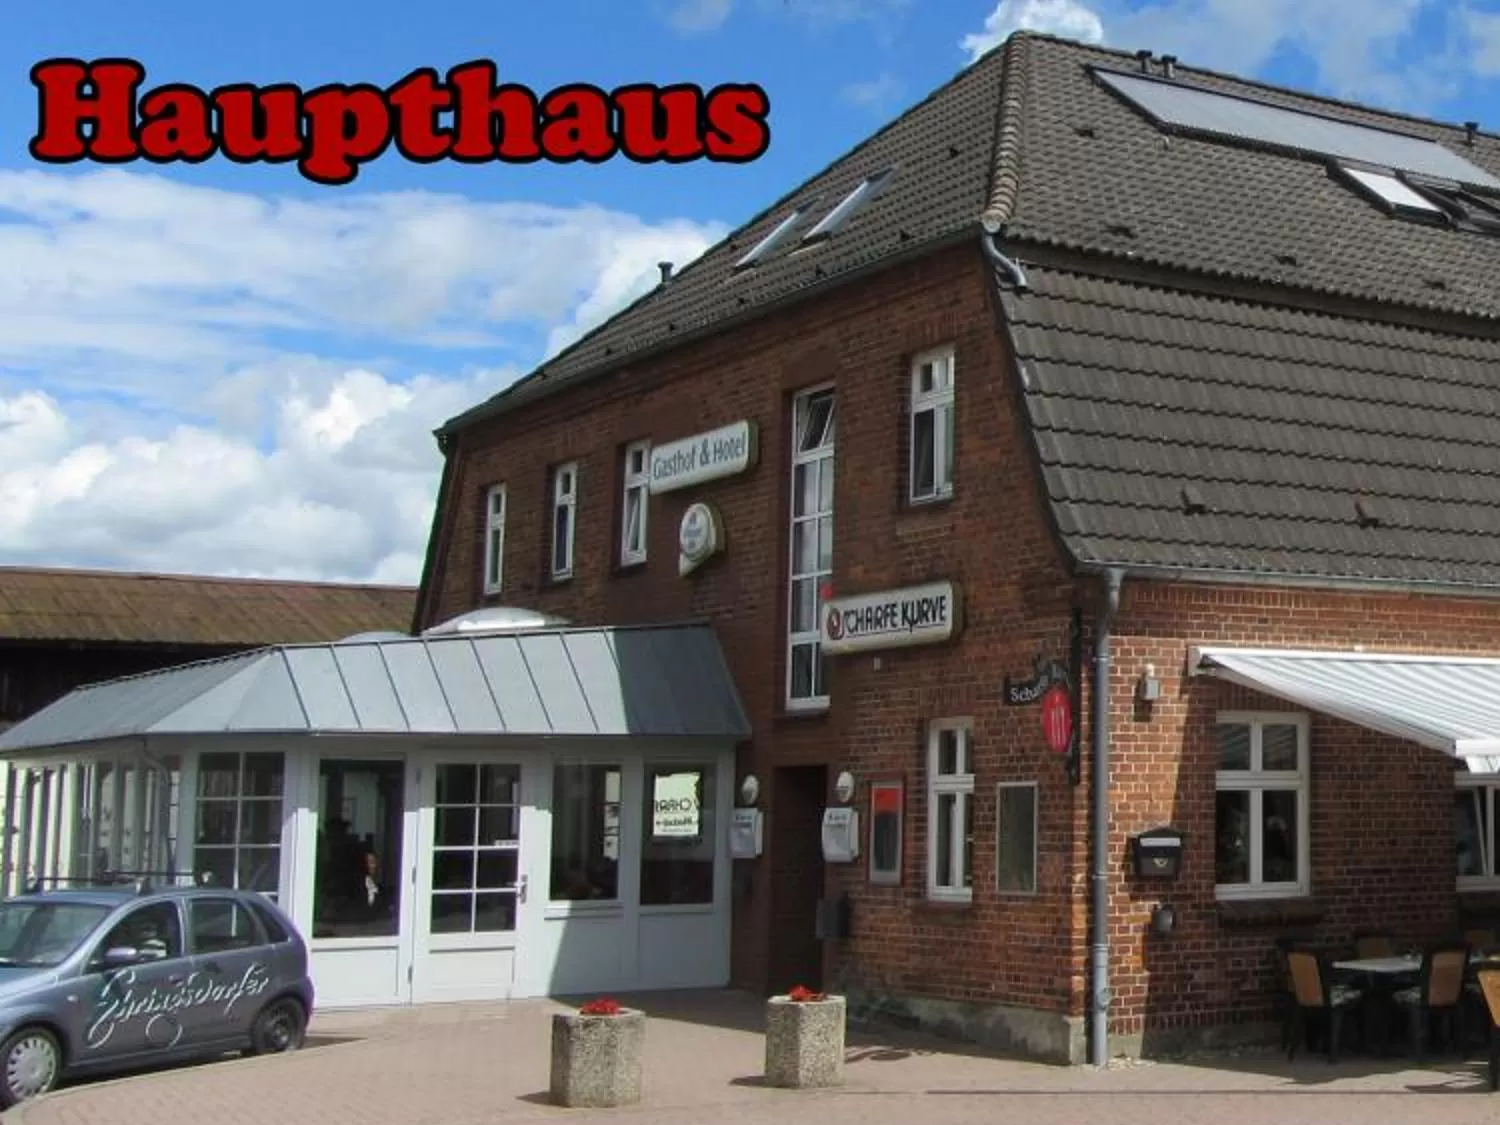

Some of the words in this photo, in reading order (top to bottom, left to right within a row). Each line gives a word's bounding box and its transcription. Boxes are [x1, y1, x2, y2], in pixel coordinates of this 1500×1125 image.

[653, 444, 697, 481] Gasthof
[699, 437, 710, 467] &
[713, 430, 747, 464] Hotel
[901, 595, 947, 633] KURVE
